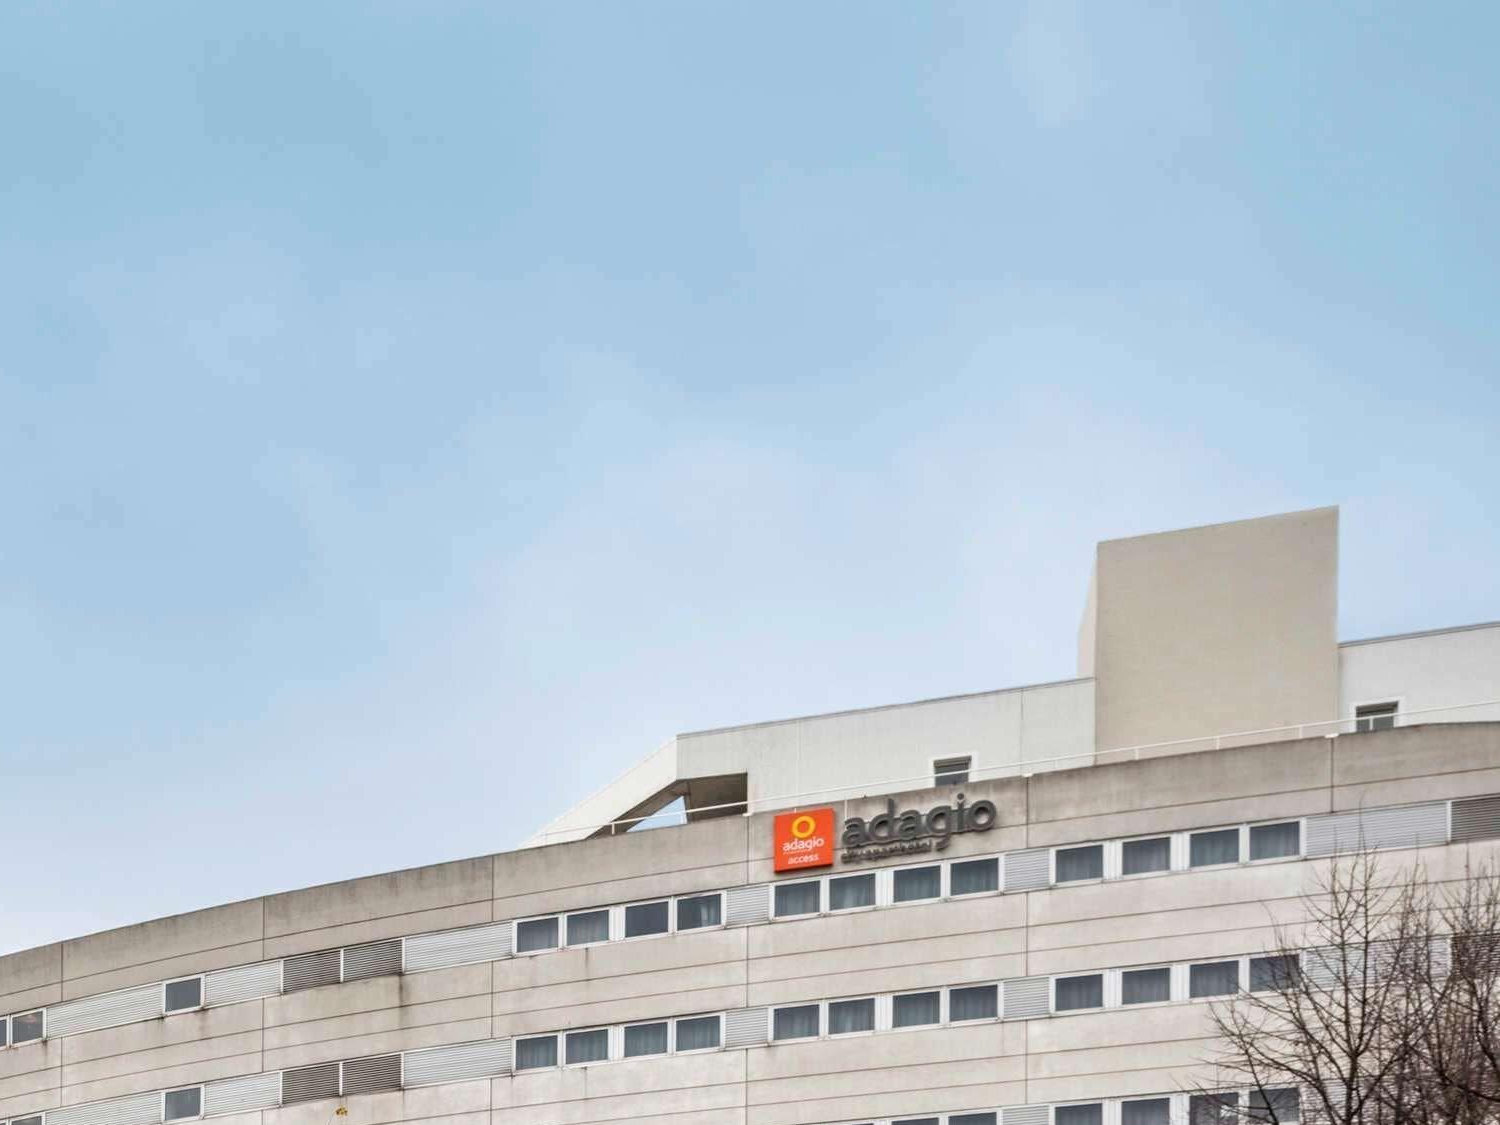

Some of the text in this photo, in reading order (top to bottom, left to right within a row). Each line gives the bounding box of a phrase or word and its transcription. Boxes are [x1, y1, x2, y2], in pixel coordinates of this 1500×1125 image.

[842, 793, 997, 852] adagio
[782, 836, 825, 852] adagio
[787, 854, 820, 865] access
